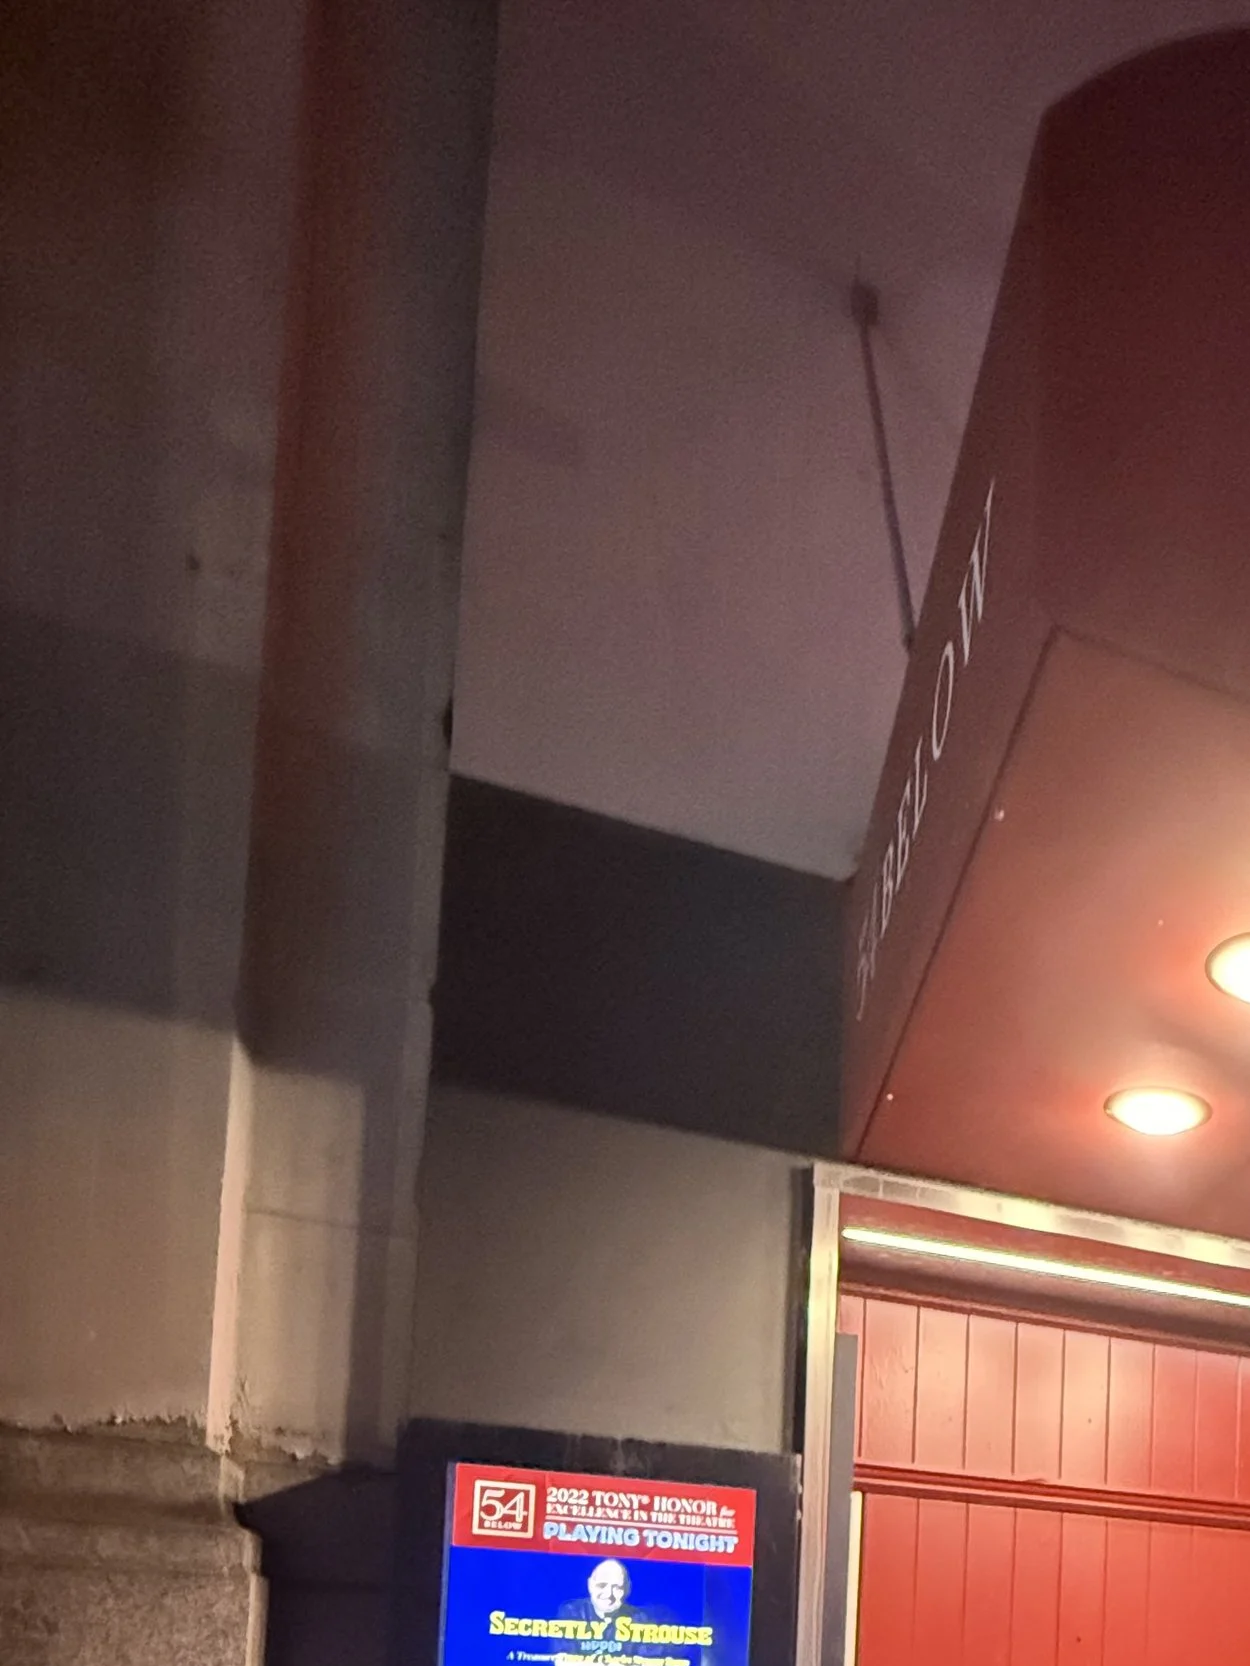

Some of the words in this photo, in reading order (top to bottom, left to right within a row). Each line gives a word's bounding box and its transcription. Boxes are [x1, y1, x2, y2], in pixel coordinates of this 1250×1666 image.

[879, 477, 996, 940] BELOW
[480, 1489, 528, 1523] 54
[546, 1487, 589, 1505] 2022
[653, 1496, 718, 1516] HONOR
[546, 1503, 632, 1521] EXCELLENCE
[633, 1510, 648, 1522] IN
[650, 1511, 677, 1524] THE
[678, 1514, 736, 1529] THEATRE
[543, 1521, 640, 1546] PLAYING
[643, 1529, 739, 1553] TONIGHT
